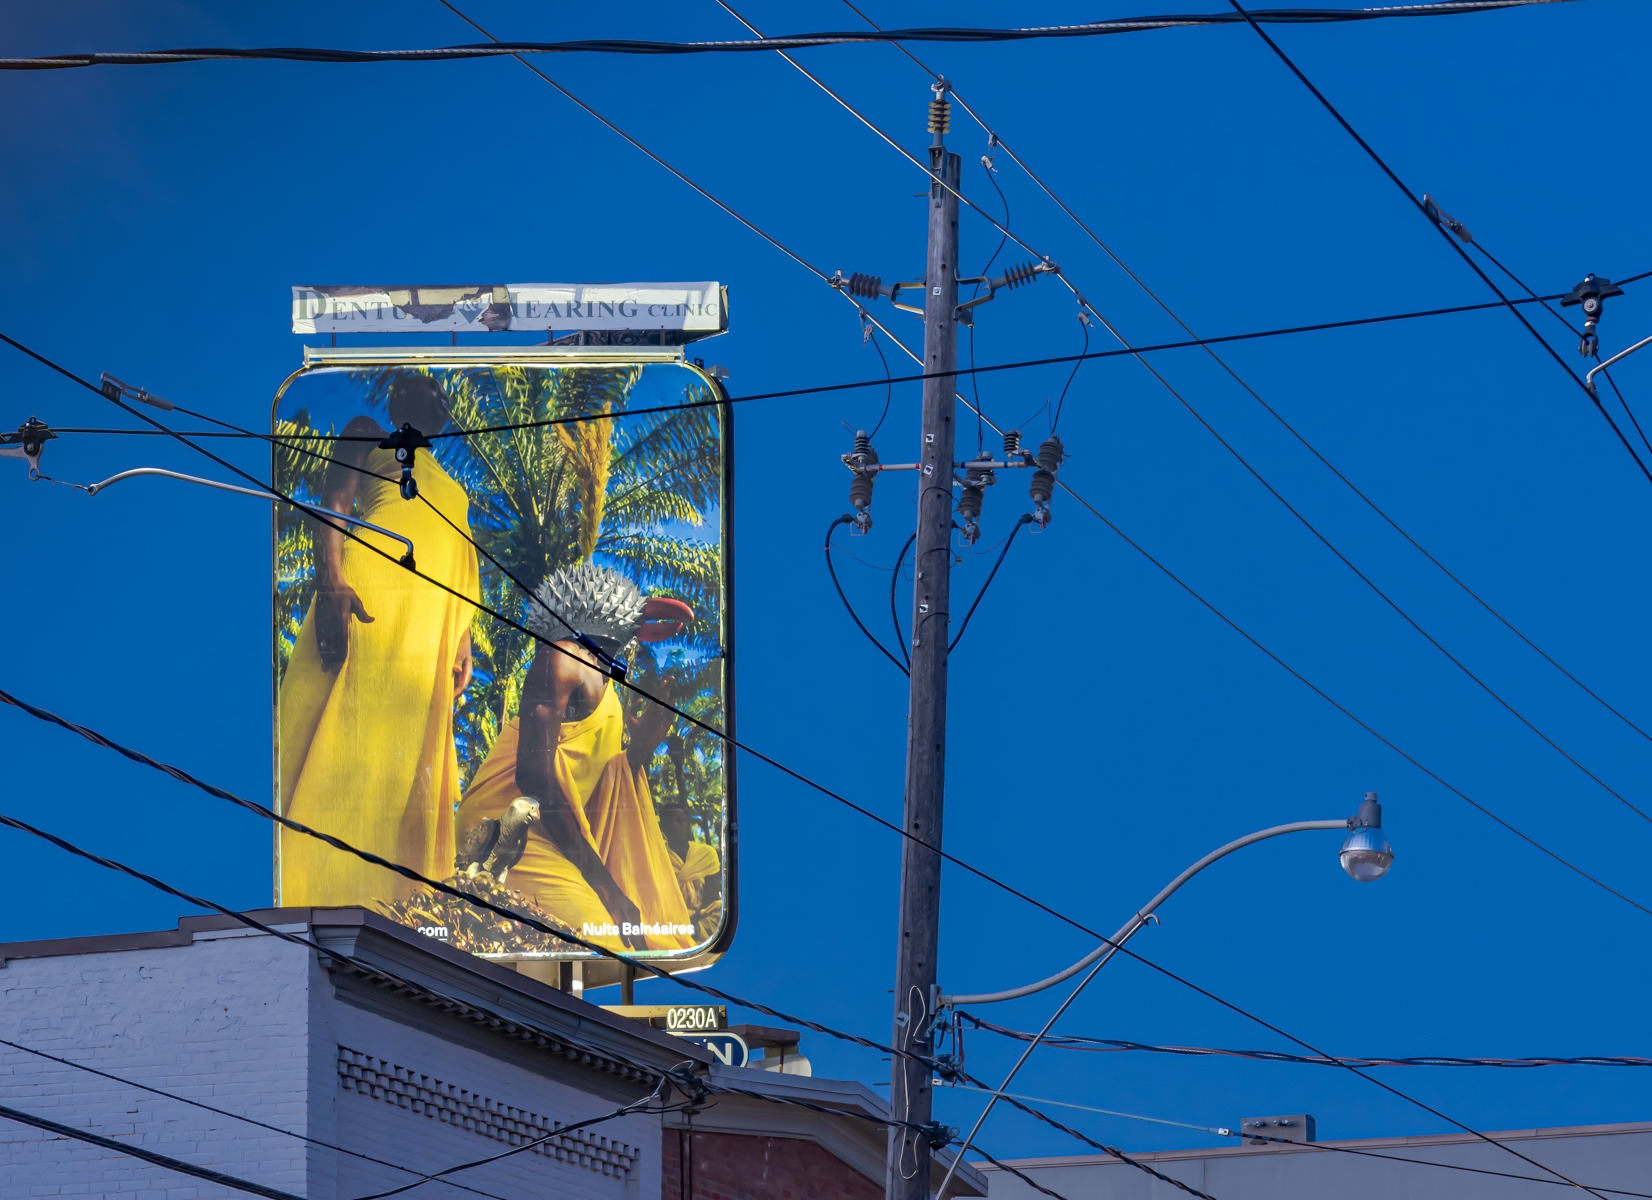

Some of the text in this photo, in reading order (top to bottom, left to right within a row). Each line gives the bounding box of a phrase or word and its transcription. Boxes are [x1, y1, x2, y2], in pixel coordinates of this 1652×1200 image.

[648, 303, 718, 317] CLINIC
[583, 921, 695, 936] Nuits Balnéaires
[667, 1007, 717, 1029] 0230A
